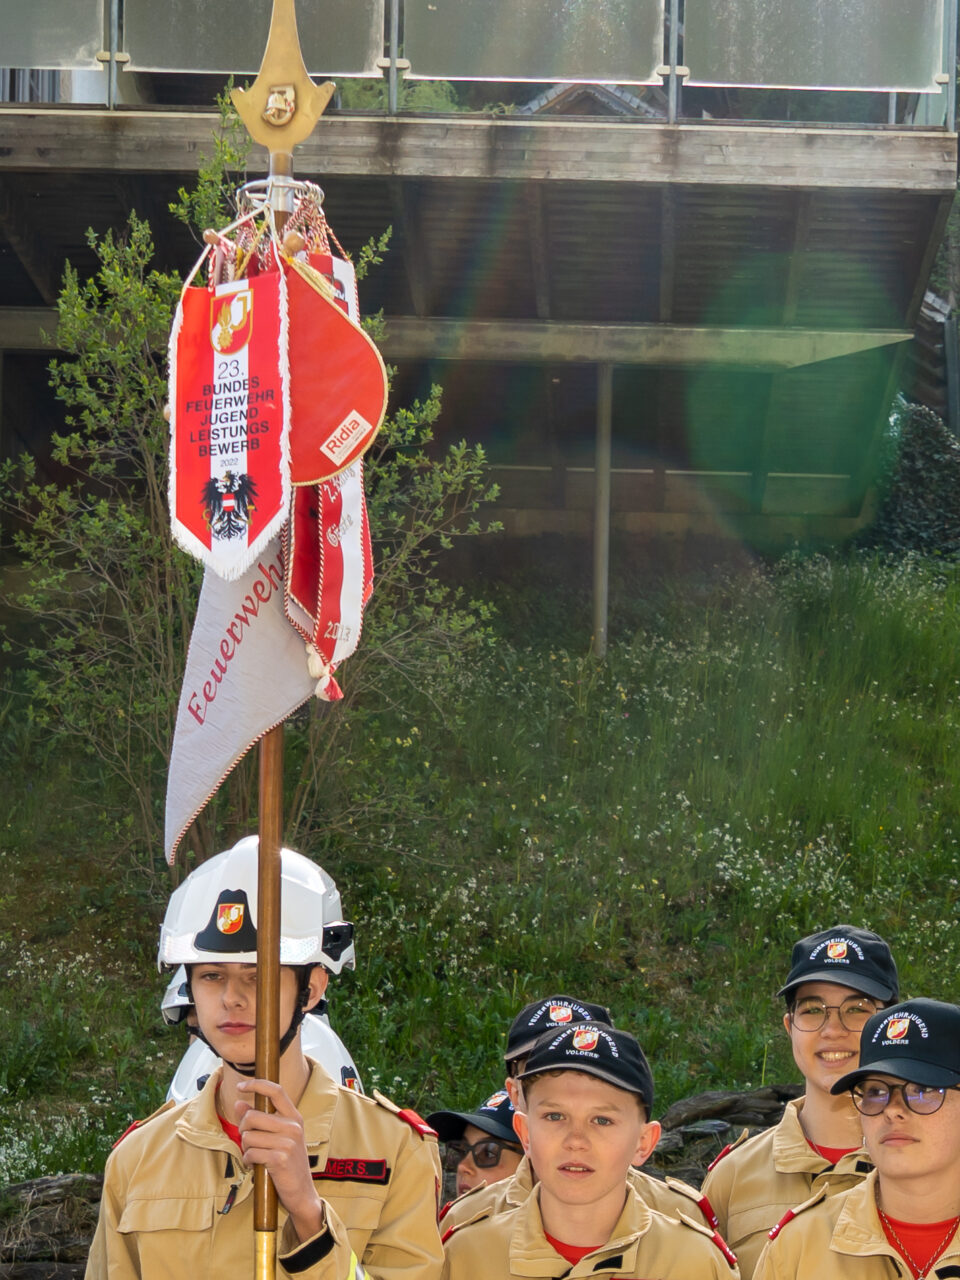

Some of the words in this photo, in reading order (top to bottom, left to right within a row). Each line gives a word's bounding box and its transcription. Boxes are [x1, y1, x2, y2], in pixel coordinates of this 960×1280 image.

[218, 359, 245, 380] 23.
[203, 376, 260, 396] BUNDES
[186, 389, 275, 413] FEUERWEHR
[201, 407, 259, 426] JUGEND
[190, 421, 270, 443] LEISTUNGS
[325, 419, 361, 455] Ridia
[198, 438, 260, 457] BEWERB
[220, 458, 239, 468] 2022
[548, 1024, 619, 1058] FEUERWEHRJUGEND
[565, 1049, 600, 1059] VOLDERS
